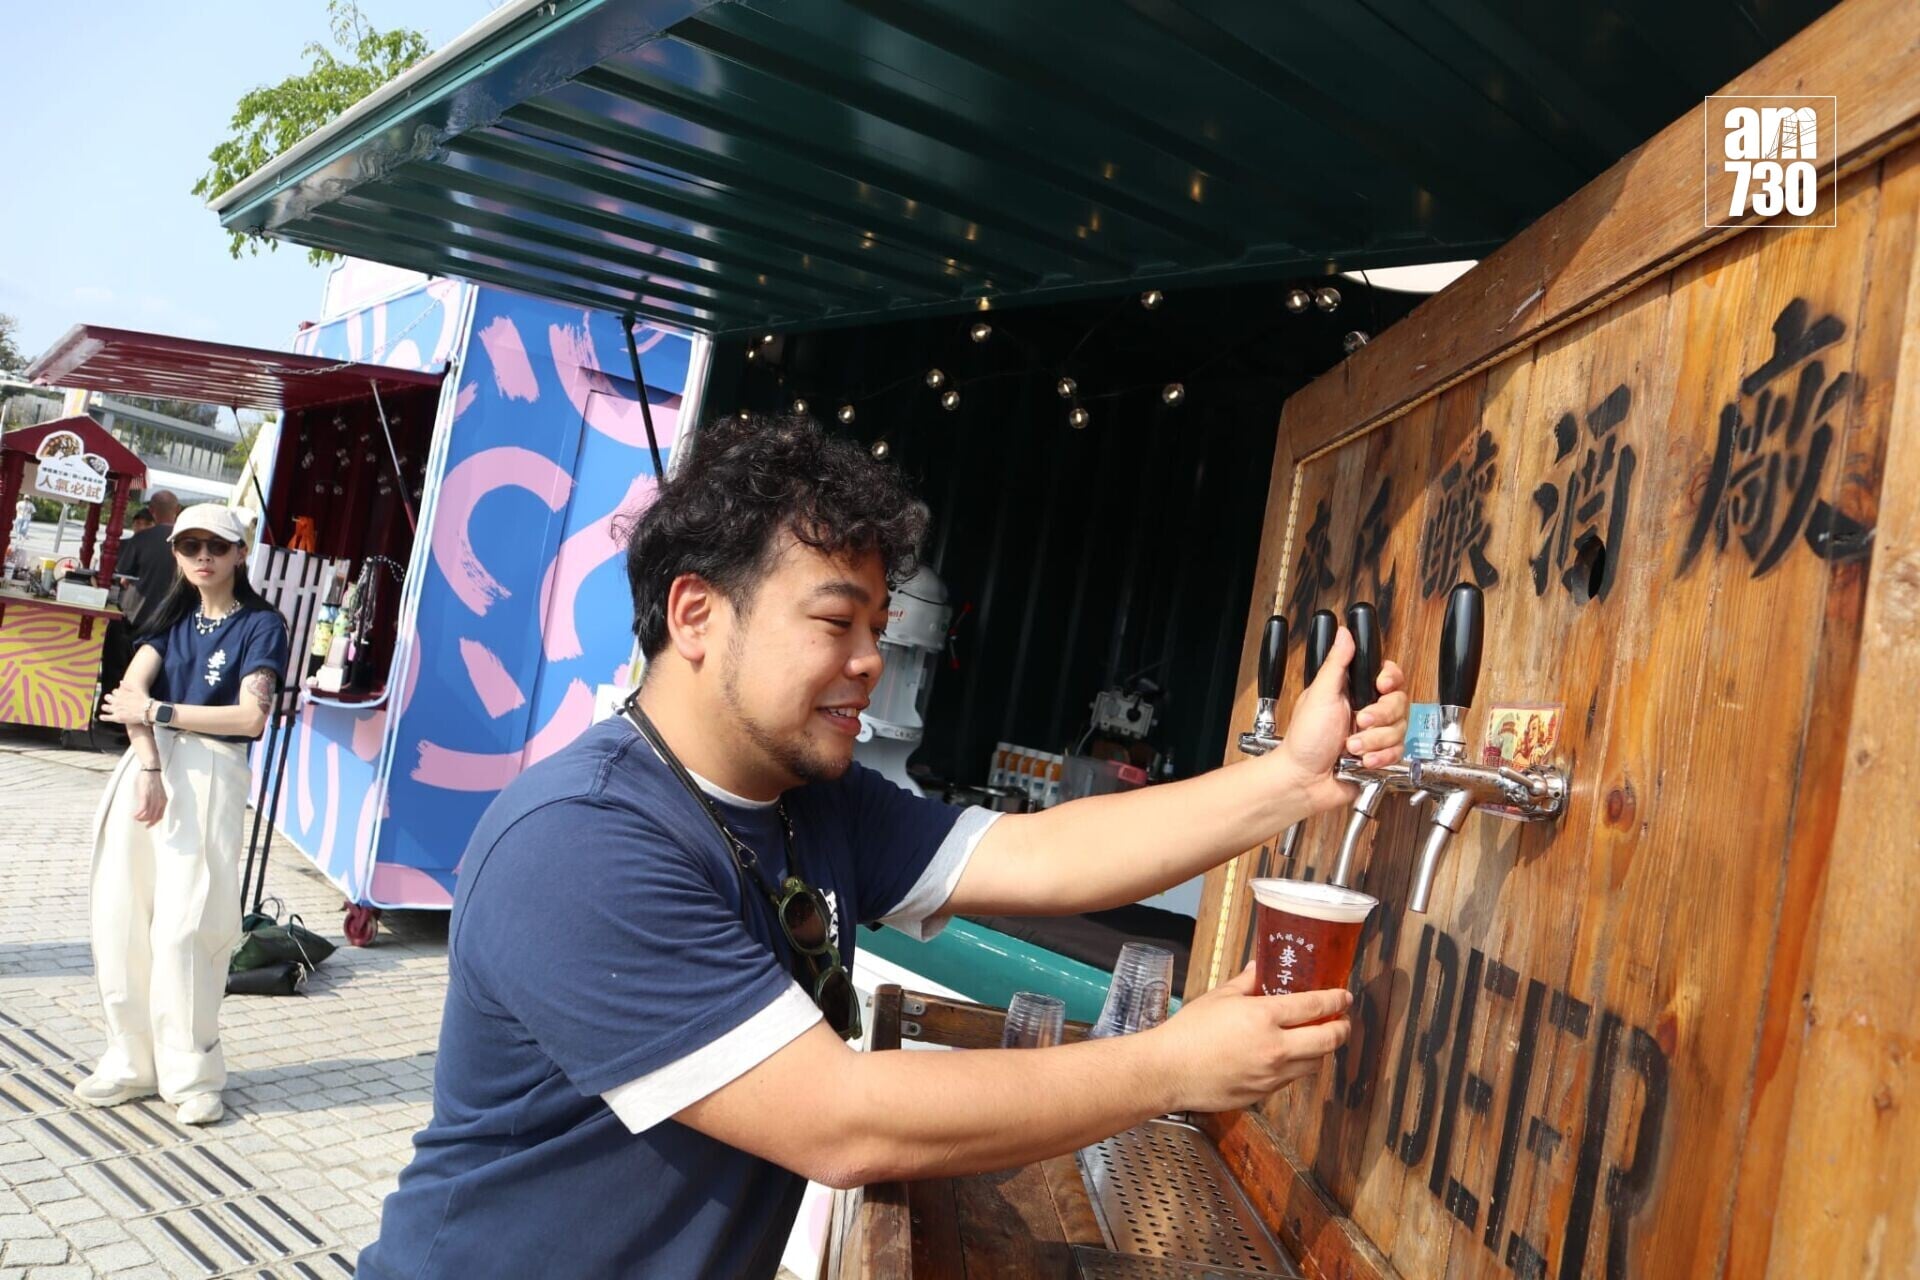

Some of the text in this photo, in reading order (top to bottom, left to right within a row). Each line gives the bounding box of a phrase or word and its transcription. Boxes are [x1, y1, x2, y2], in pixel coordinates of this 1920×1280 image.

[37, 474, 102, 500] 人氣必試
[1385, 922, 1669, 1280] BEER
